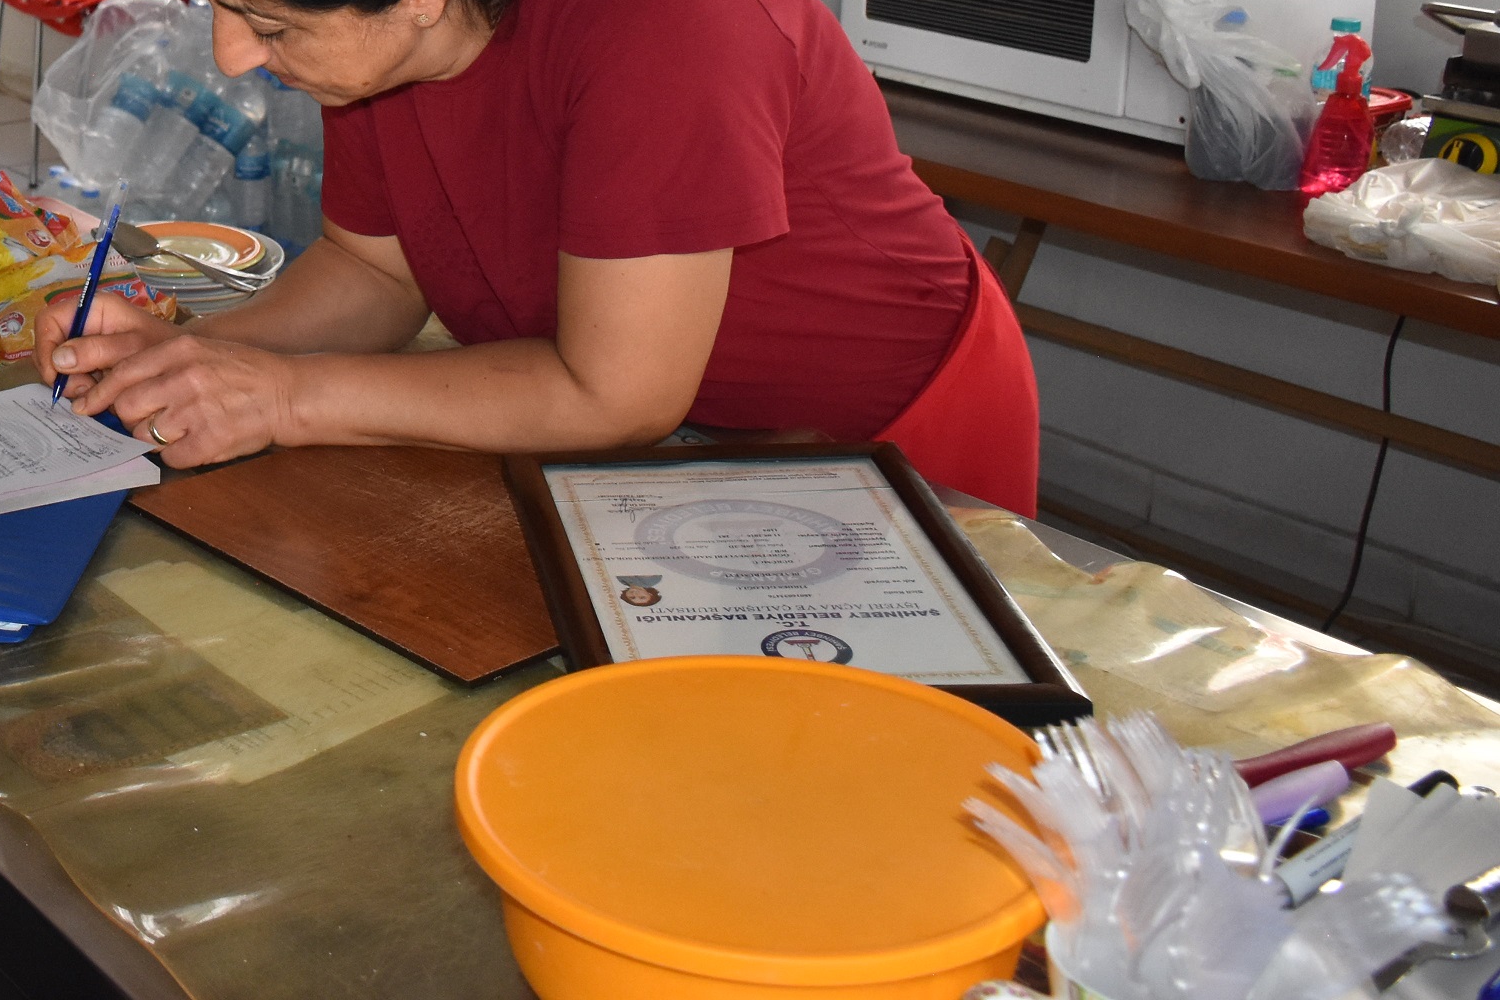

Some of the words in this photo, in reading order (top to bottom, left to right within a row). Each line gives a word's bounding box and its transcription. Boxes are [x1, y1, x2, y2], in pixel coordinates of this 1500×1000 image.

[721, 603, 792, 612] ÇALIŞMA
[816, 602, 864, 610] AÇMA
[865, 601, 921, 610] İŞYERİ
[634, 613, 748, 623] BAŞKANLIĞI
[752, 612, 843, 620] BELEDİYE
[845, 609, 942, 618] ŞAHİNBEY
